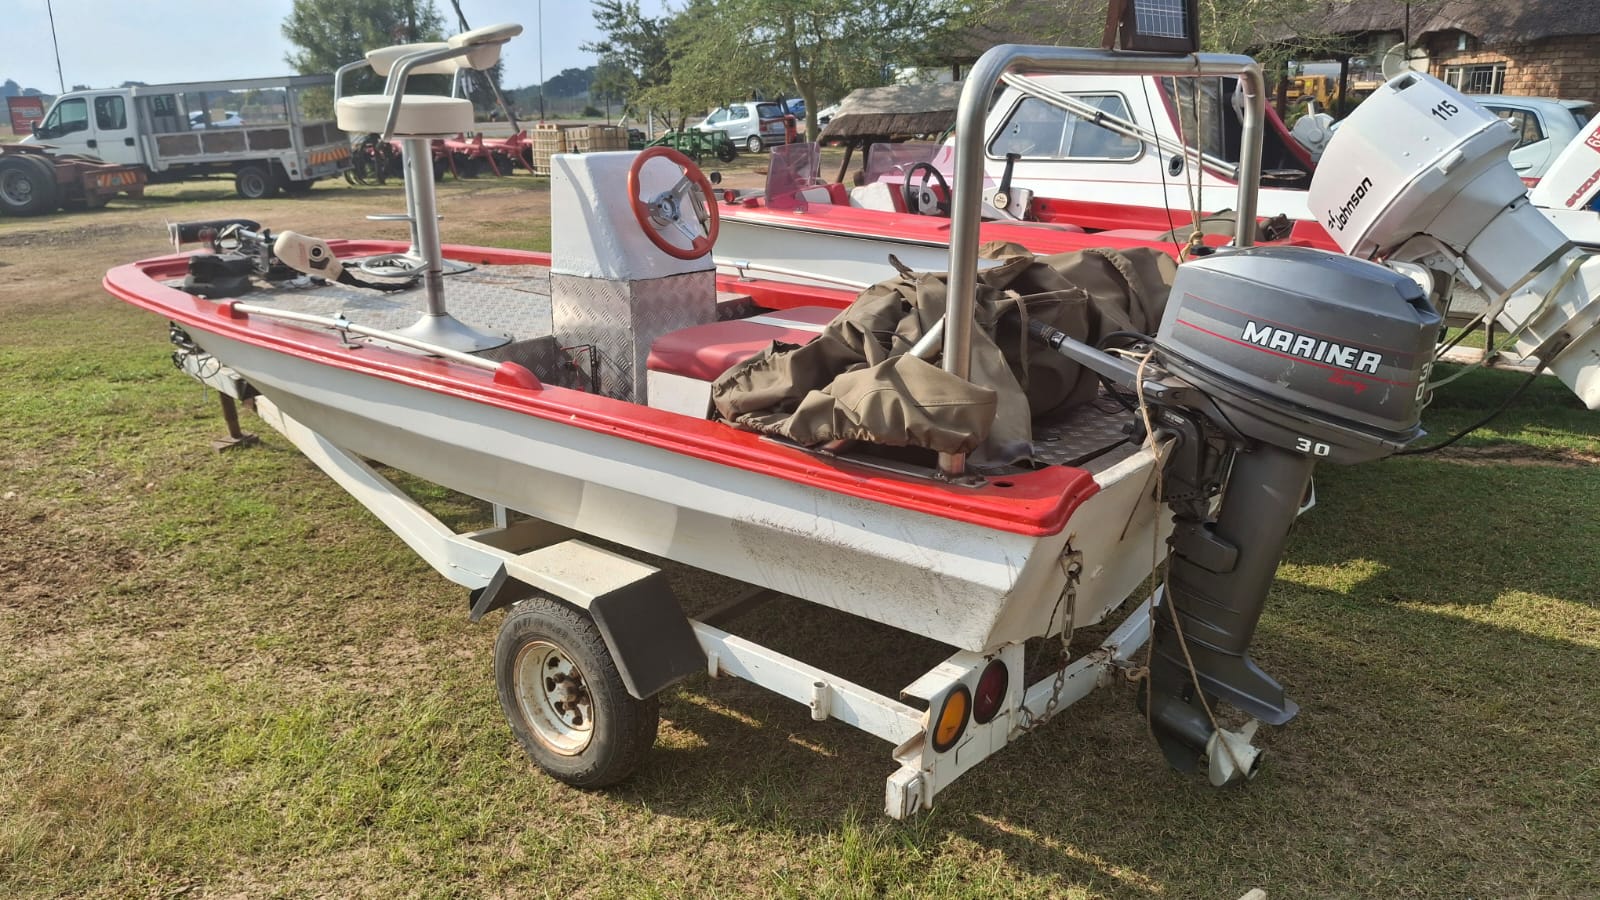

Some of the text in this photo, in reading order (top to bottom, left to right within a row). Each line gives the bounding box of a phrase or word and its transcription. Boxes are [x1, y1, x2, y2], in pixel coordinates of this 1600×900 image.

[1431, 100, 1459, 121] 115
[1335, 176, 1373, 232] Johnson
[1241, 320, 1383, 374] MARINER
[1295, 437, 1331, 457] 30
